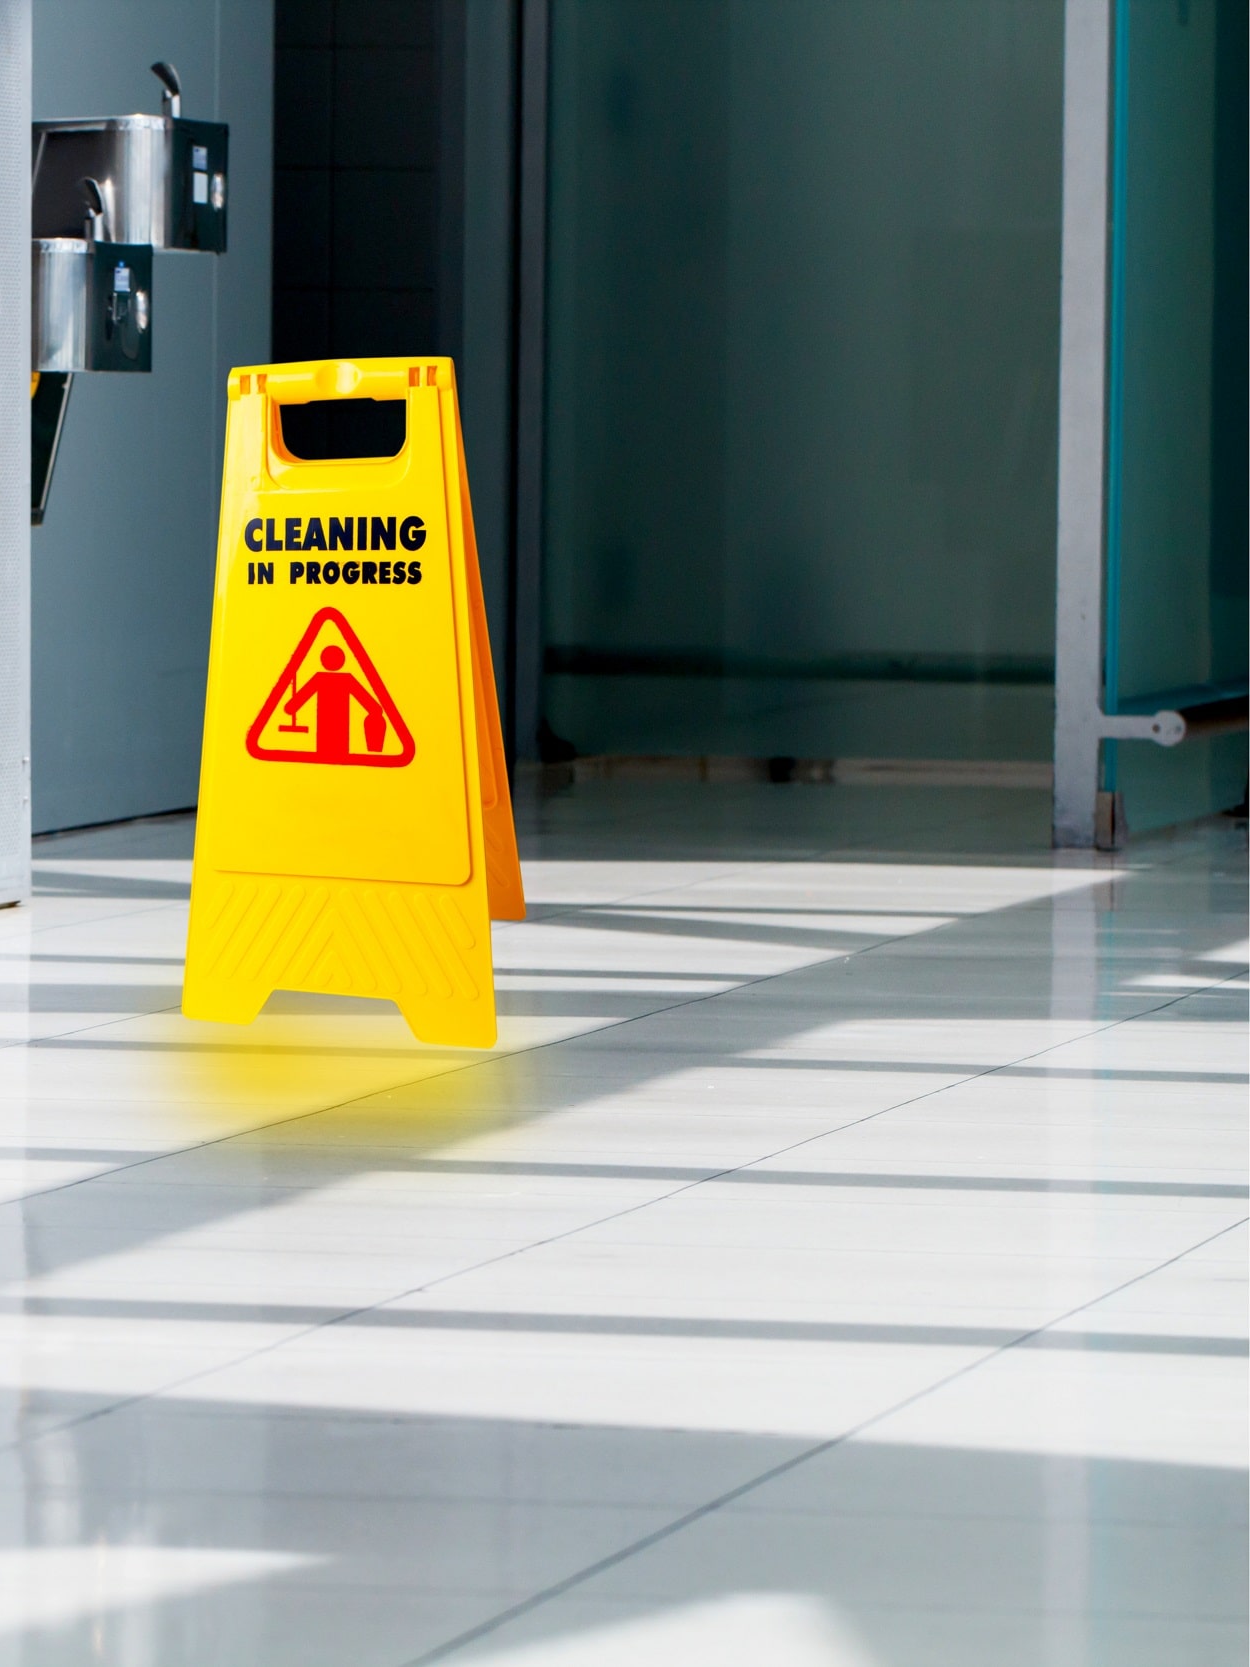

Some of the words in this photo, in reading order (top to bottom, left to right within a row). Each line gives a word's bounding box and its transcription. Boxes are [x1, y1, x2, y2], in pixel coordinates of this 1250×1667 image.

[244, 515, 427, 552] CLEANING
[247, 562, 274, 585] IN
[290, 561, 422, 585] PROGRESS
